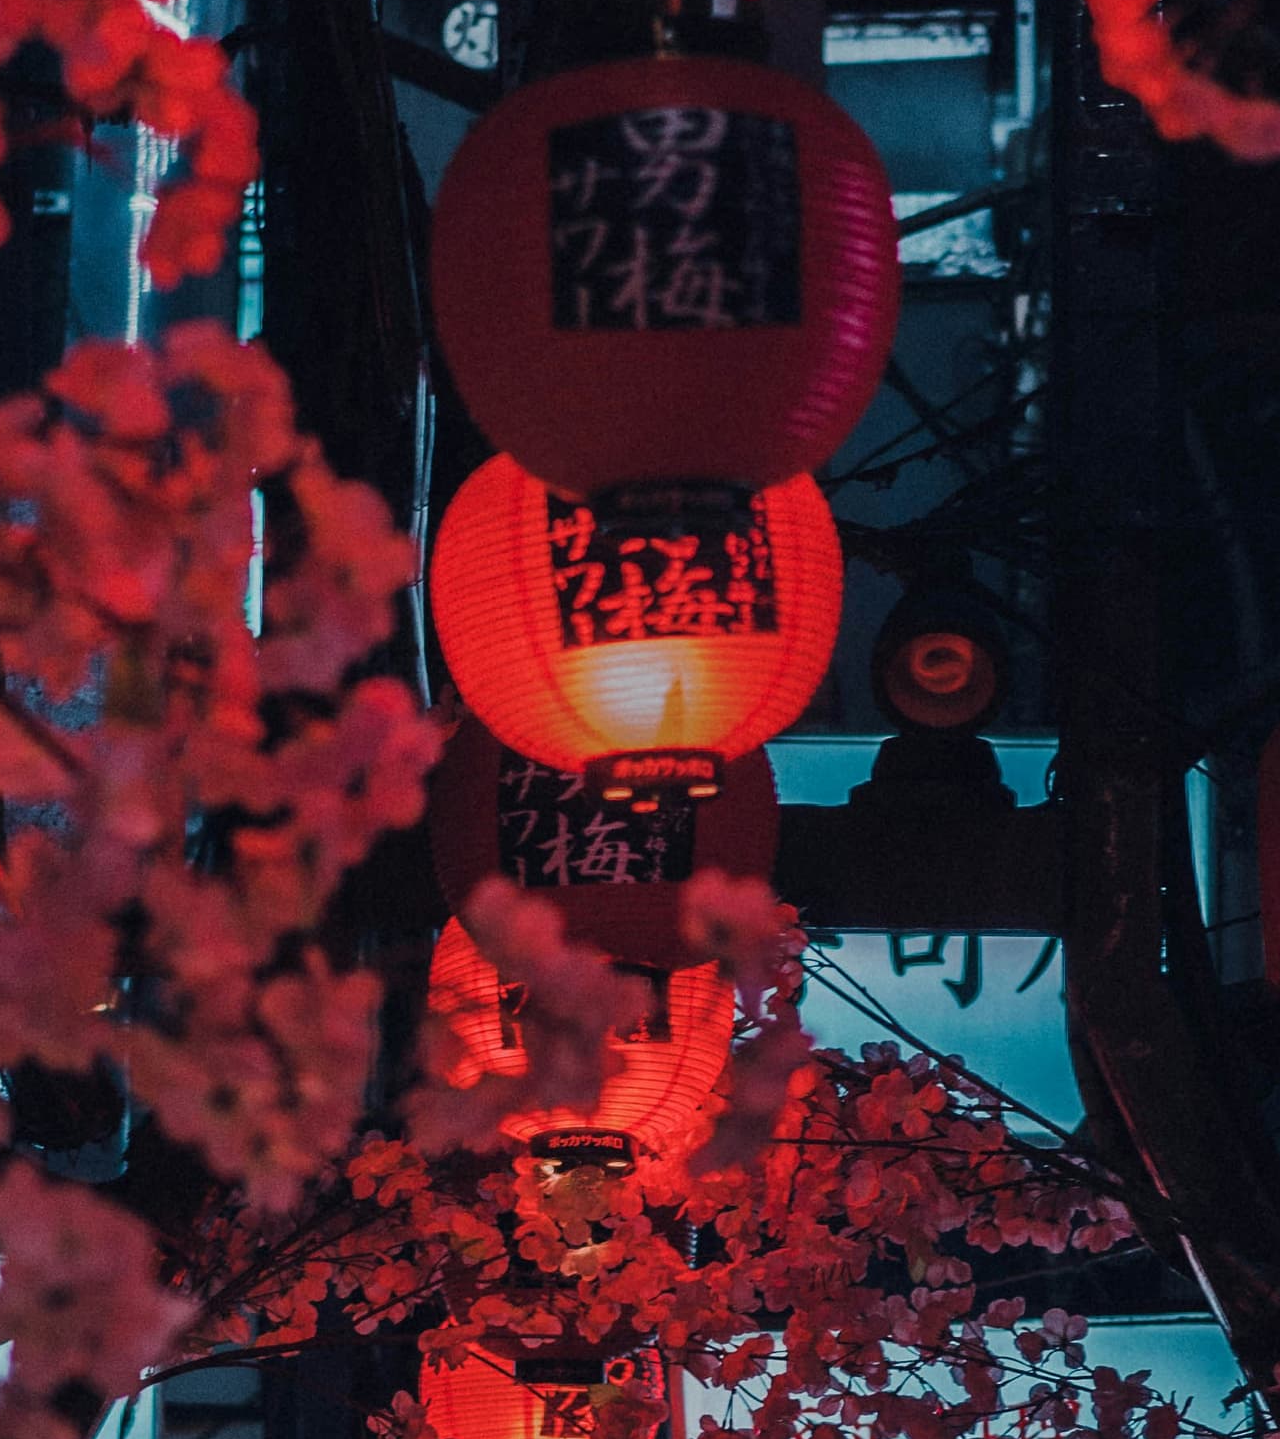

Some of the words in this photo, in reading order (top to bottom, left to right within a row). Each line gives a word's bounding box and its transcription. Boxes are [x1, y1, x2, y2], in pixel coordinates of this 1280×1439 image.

[550, 157, 610, 331] サワー
[608, 107, 748, 333] 男梅
[548, 506, 608, 645] サワー
